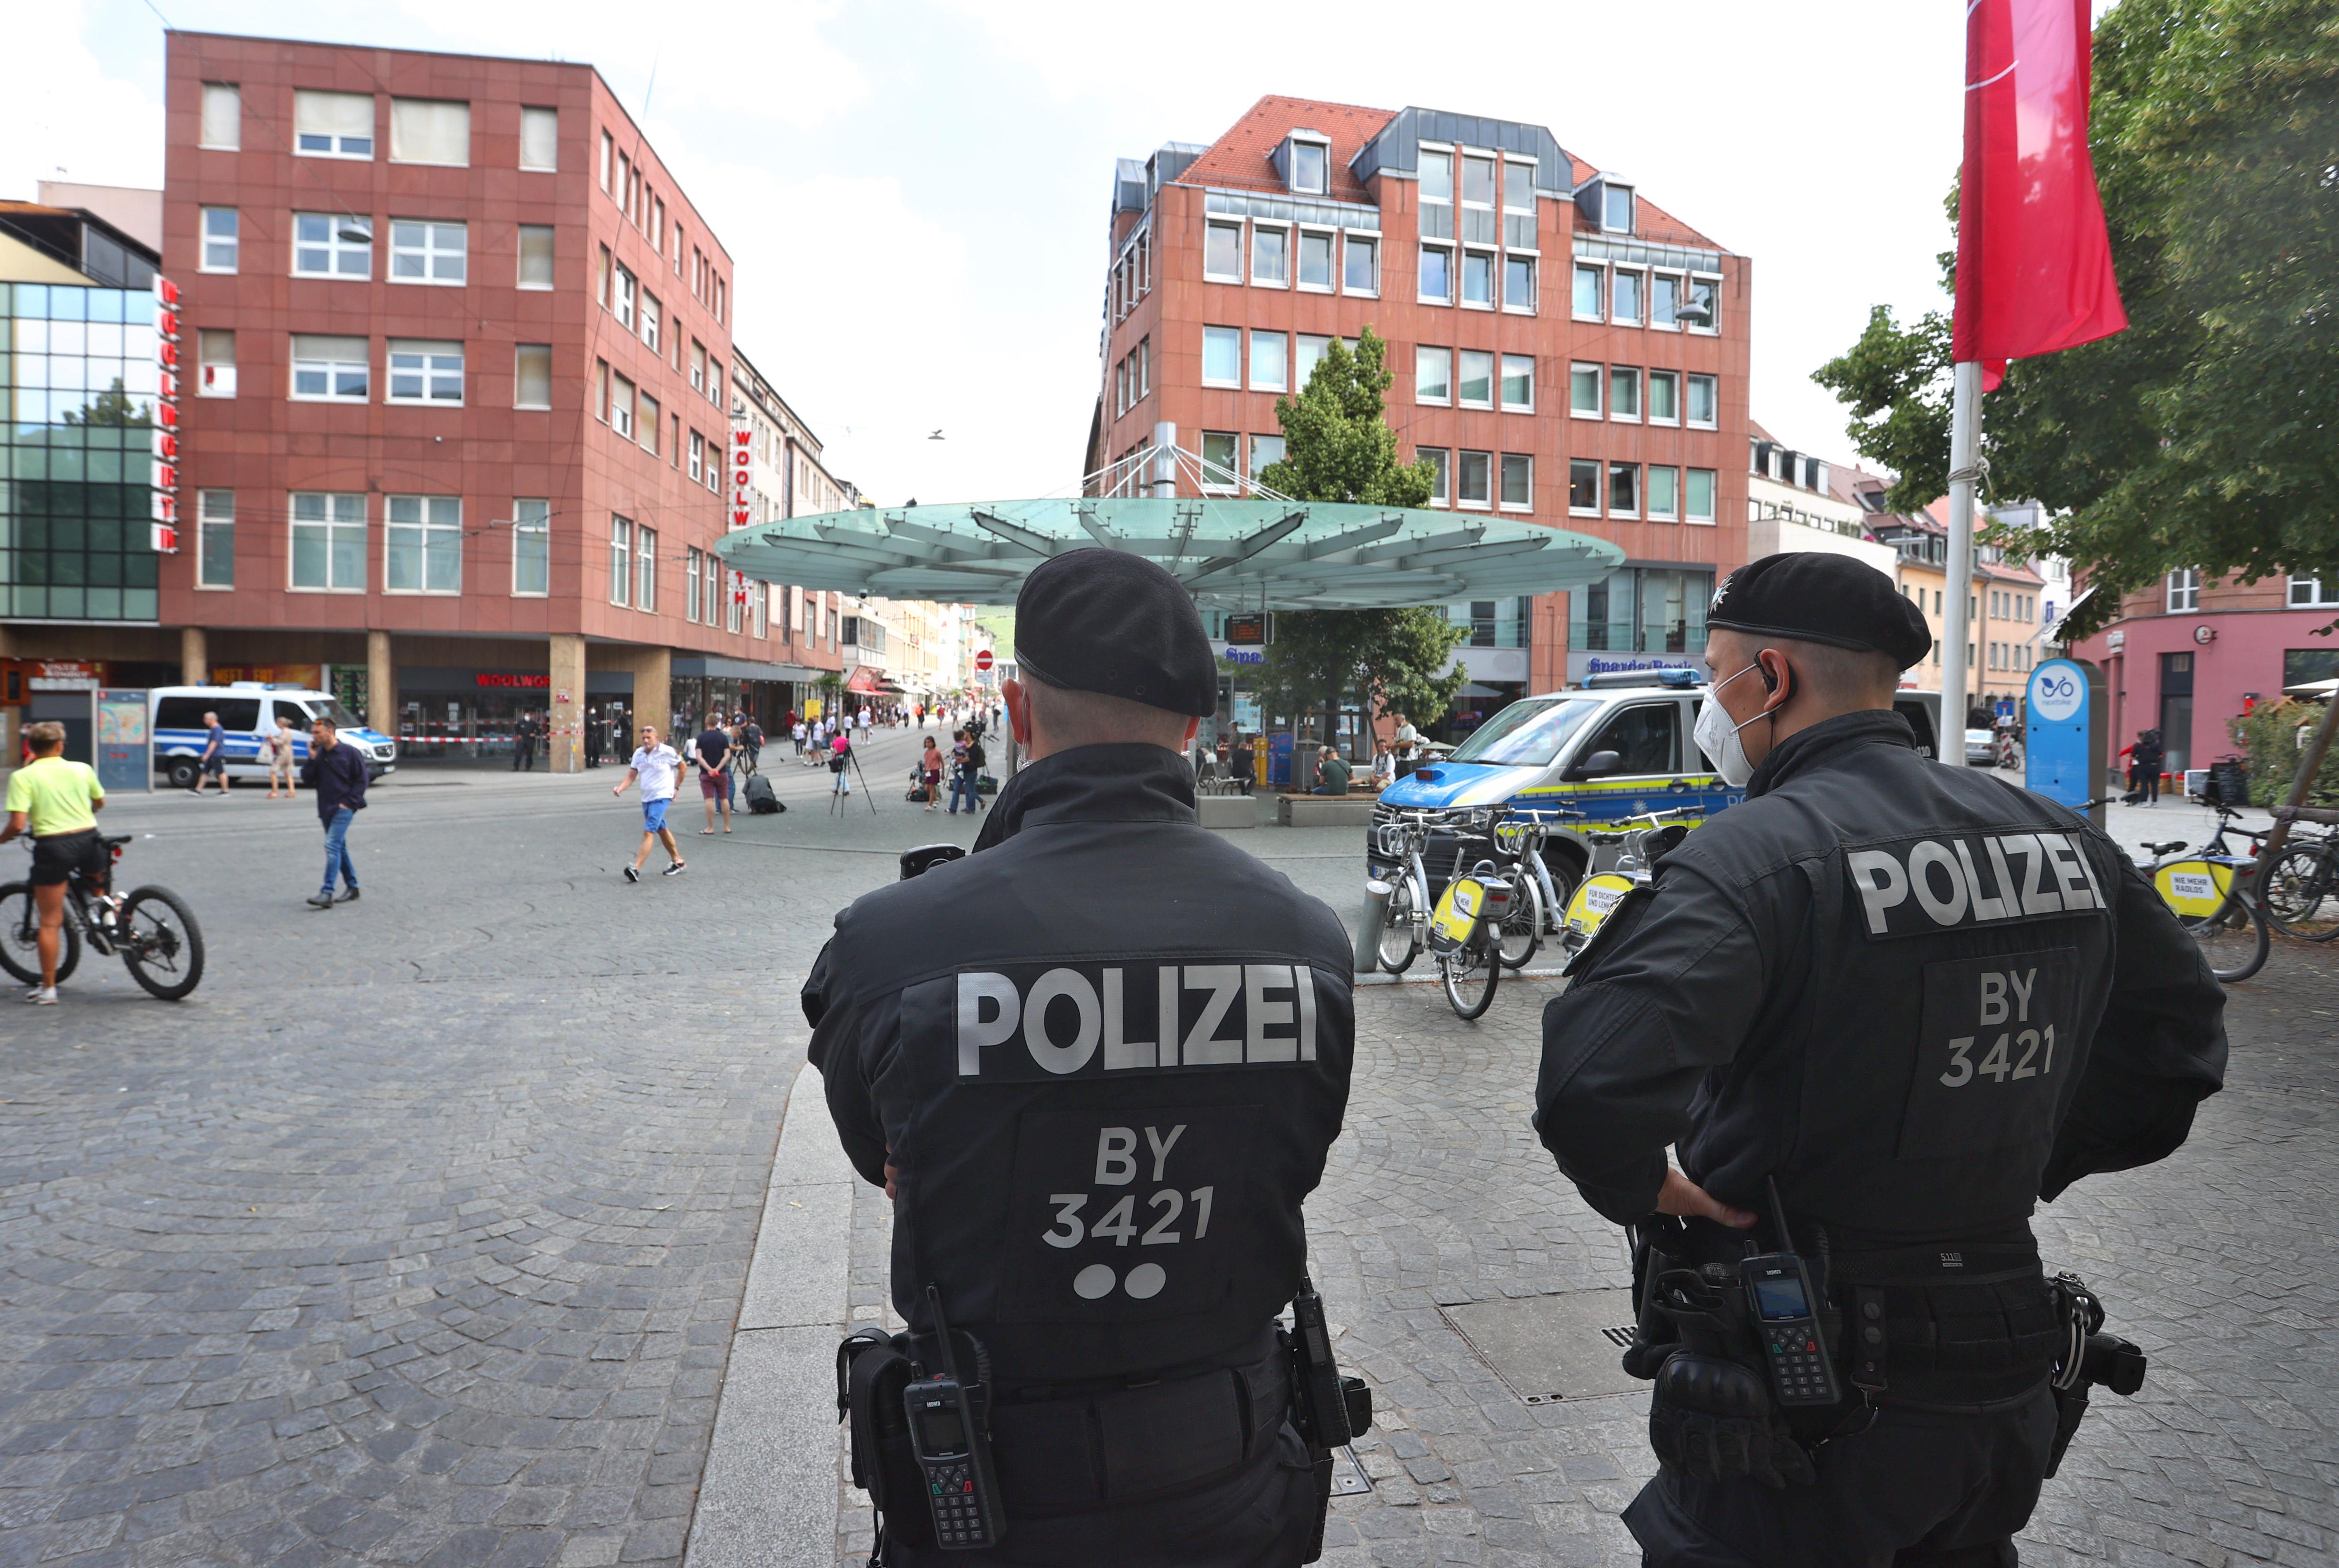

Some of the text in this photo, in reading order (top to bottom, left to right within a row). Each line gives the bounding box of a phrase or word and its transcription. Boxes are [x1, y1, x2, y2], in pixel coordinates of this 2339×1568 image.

[735, 431, 751, 604] WOOLWTH
[1460, 897, 1469, 907] MEHR
[1589, 889, 1598, 897] FÜR
[1589, 898, 1598, 907] UND
[1848, 833, 2107, 934] POLIZEI
[2175, 885, 2204, 894] RADLOS
[2187, 878, 2207, 886] MEHR
[958, 964, 1316, 1076] POLIZEI
[1980, 968, 2037, 1026] BY
[1939, 1024, 2055, 1087] 3421
[1095, 1125, 1187, 1185] BY
[1042, 1186, 1213, 1249] 3421
